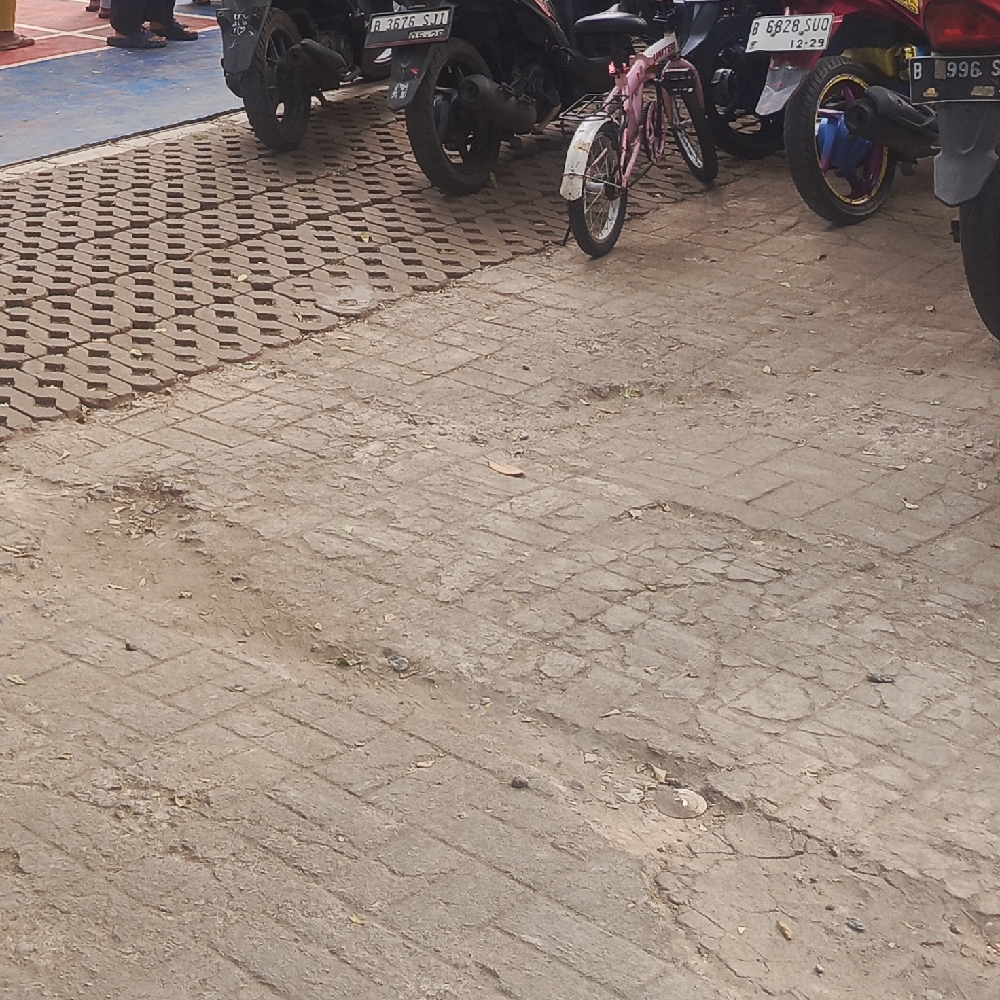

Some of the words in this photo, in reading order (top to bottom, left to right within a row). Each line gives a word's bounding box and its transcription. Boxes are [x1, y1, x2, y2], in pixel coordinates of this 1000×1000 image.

[387, 15, 415, 31] 3676
[752, 21, 760, 36] B
[765, 19, 800, 34] 6828
[913, 62, 922, 80] B
